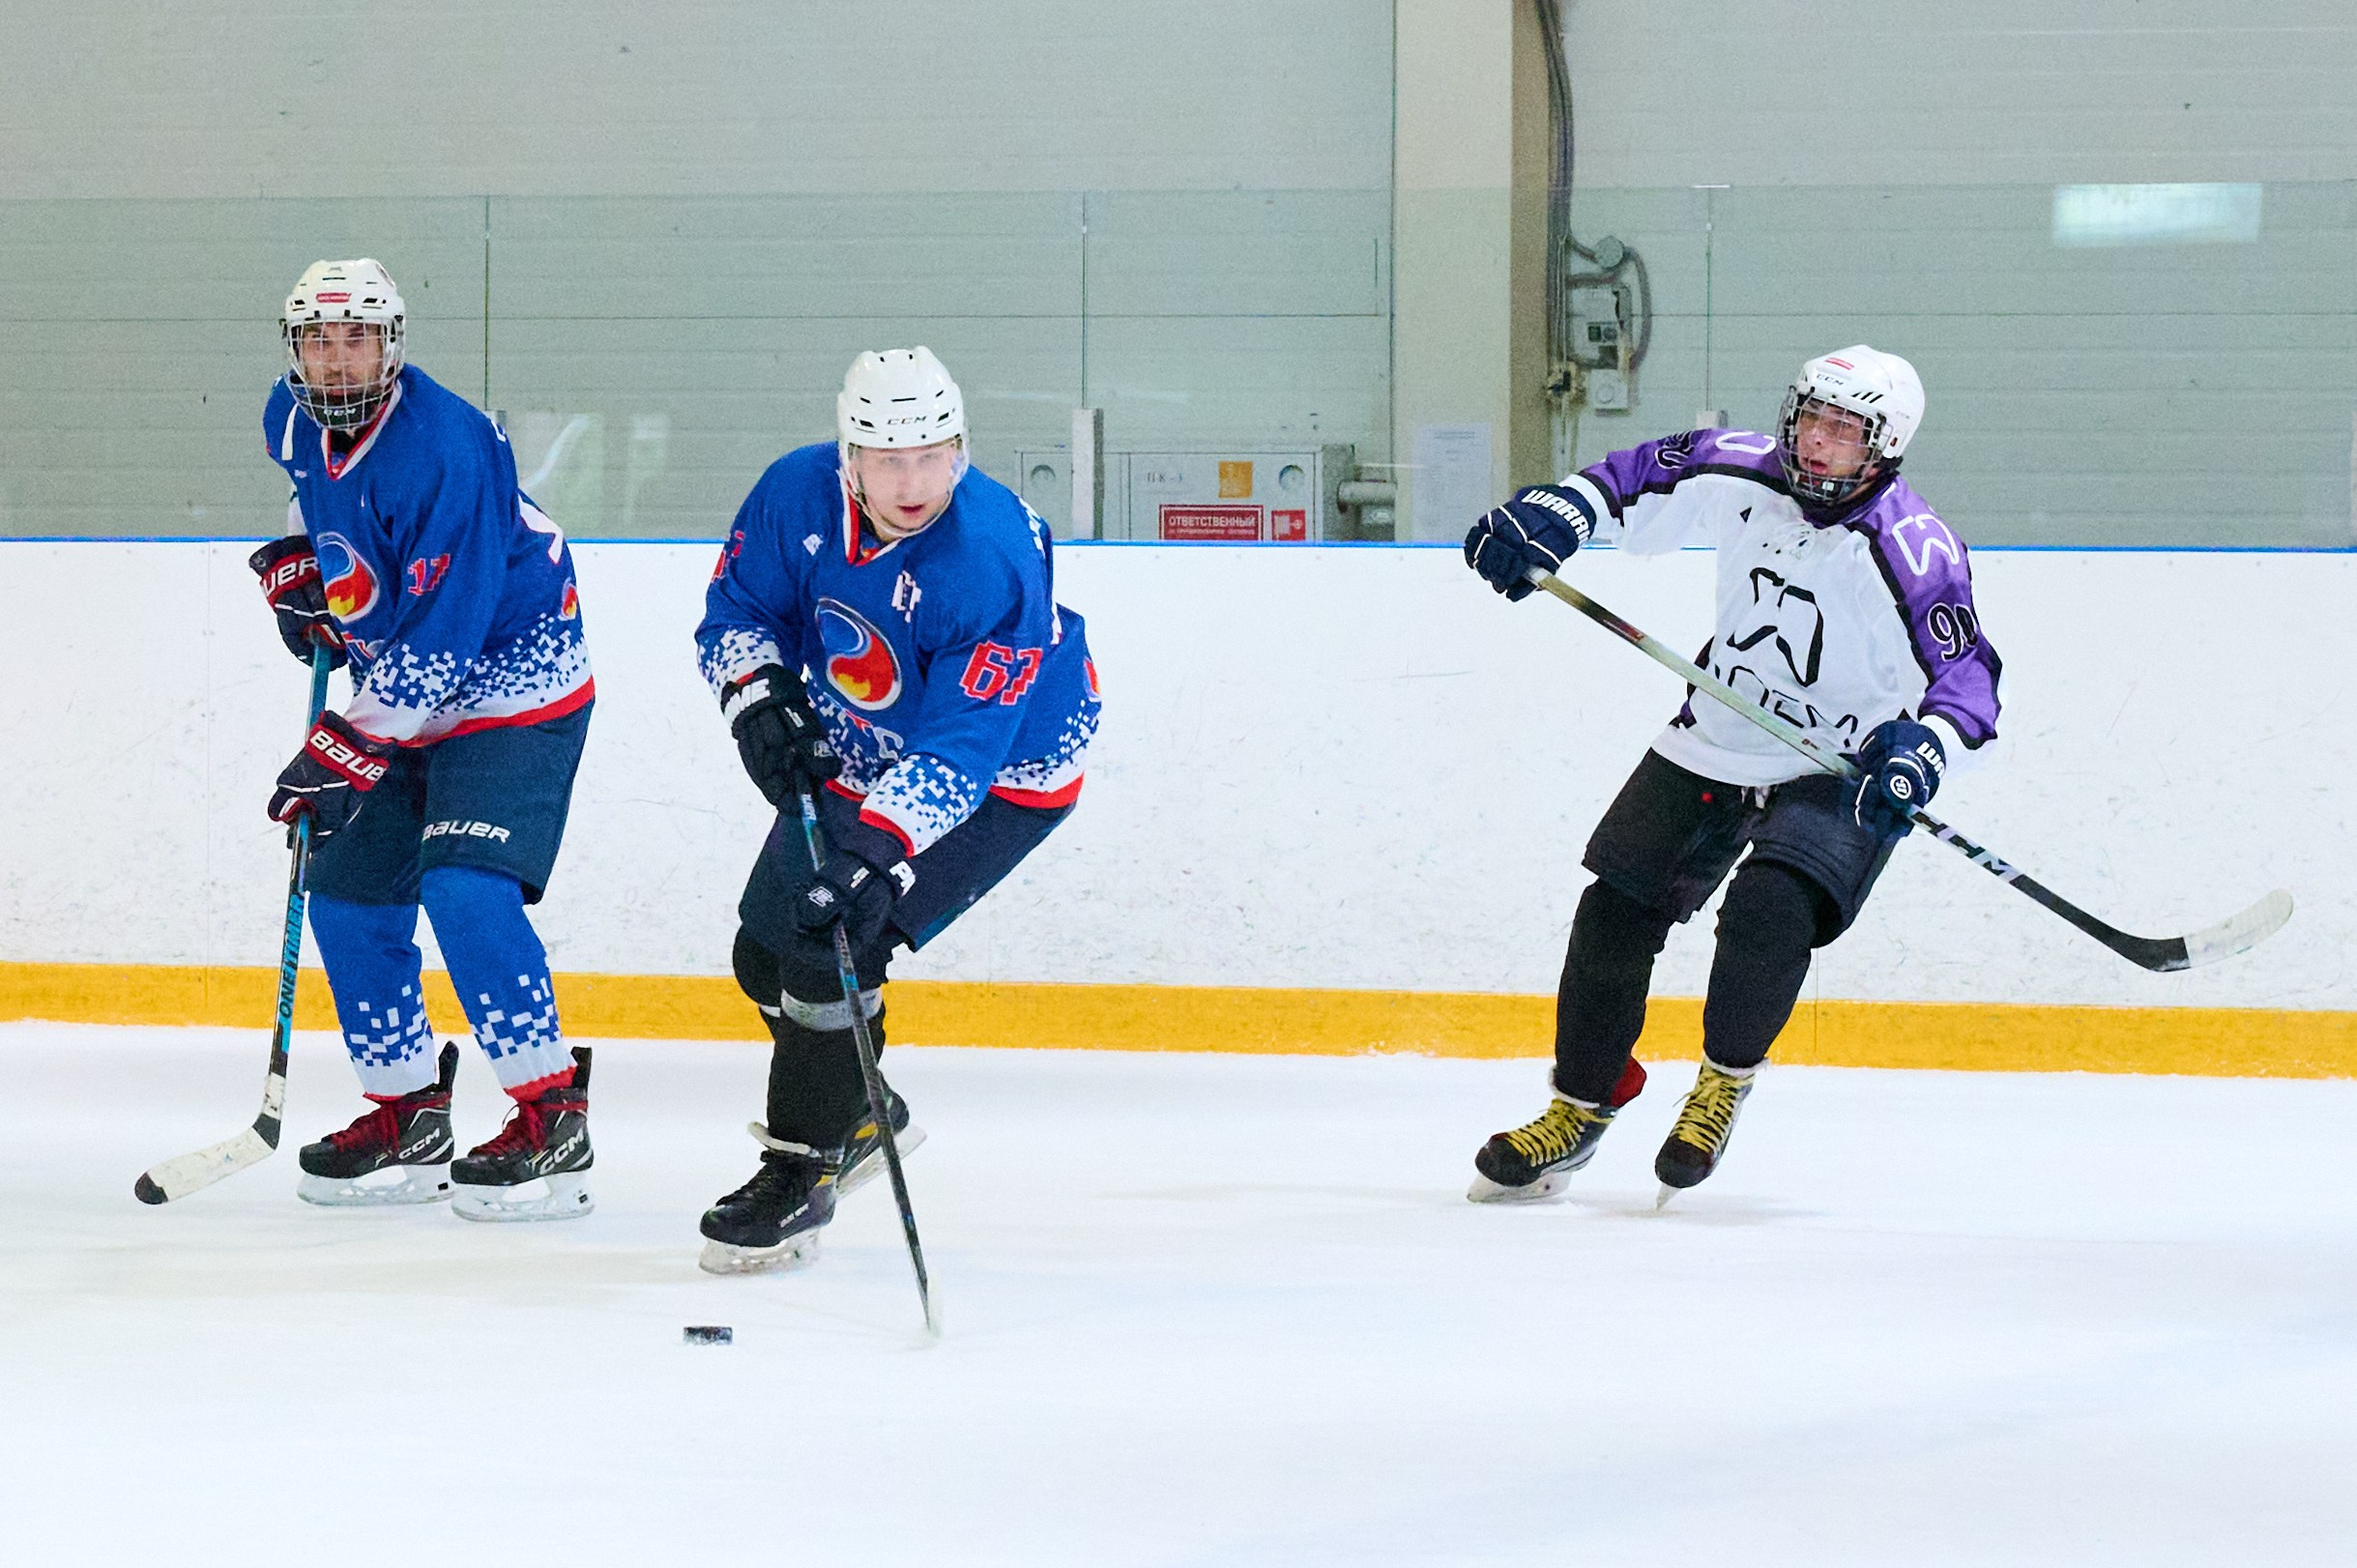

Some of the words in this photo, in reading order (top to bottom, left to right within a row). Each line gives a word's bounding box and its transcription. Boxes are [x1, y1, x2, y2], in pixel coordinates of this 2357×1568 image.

[1817, 373, 1845, 386] CCM
[888, 416, 927, 425] CCM
[1168, 514, 1256, 528] ОТВЕТСТВЕННЫЙ
[1521, 489, 1590, 545] WARRI
[407, 552, 451, 596] 17
[1927, 601, 1980, 662] 90
[958, 639, 1043, 706] 67
[422, 819, 510, 843] BAUER
[398, 1128, 441, 1159] CCM
[538, 1127, 585, 1176] CCM
